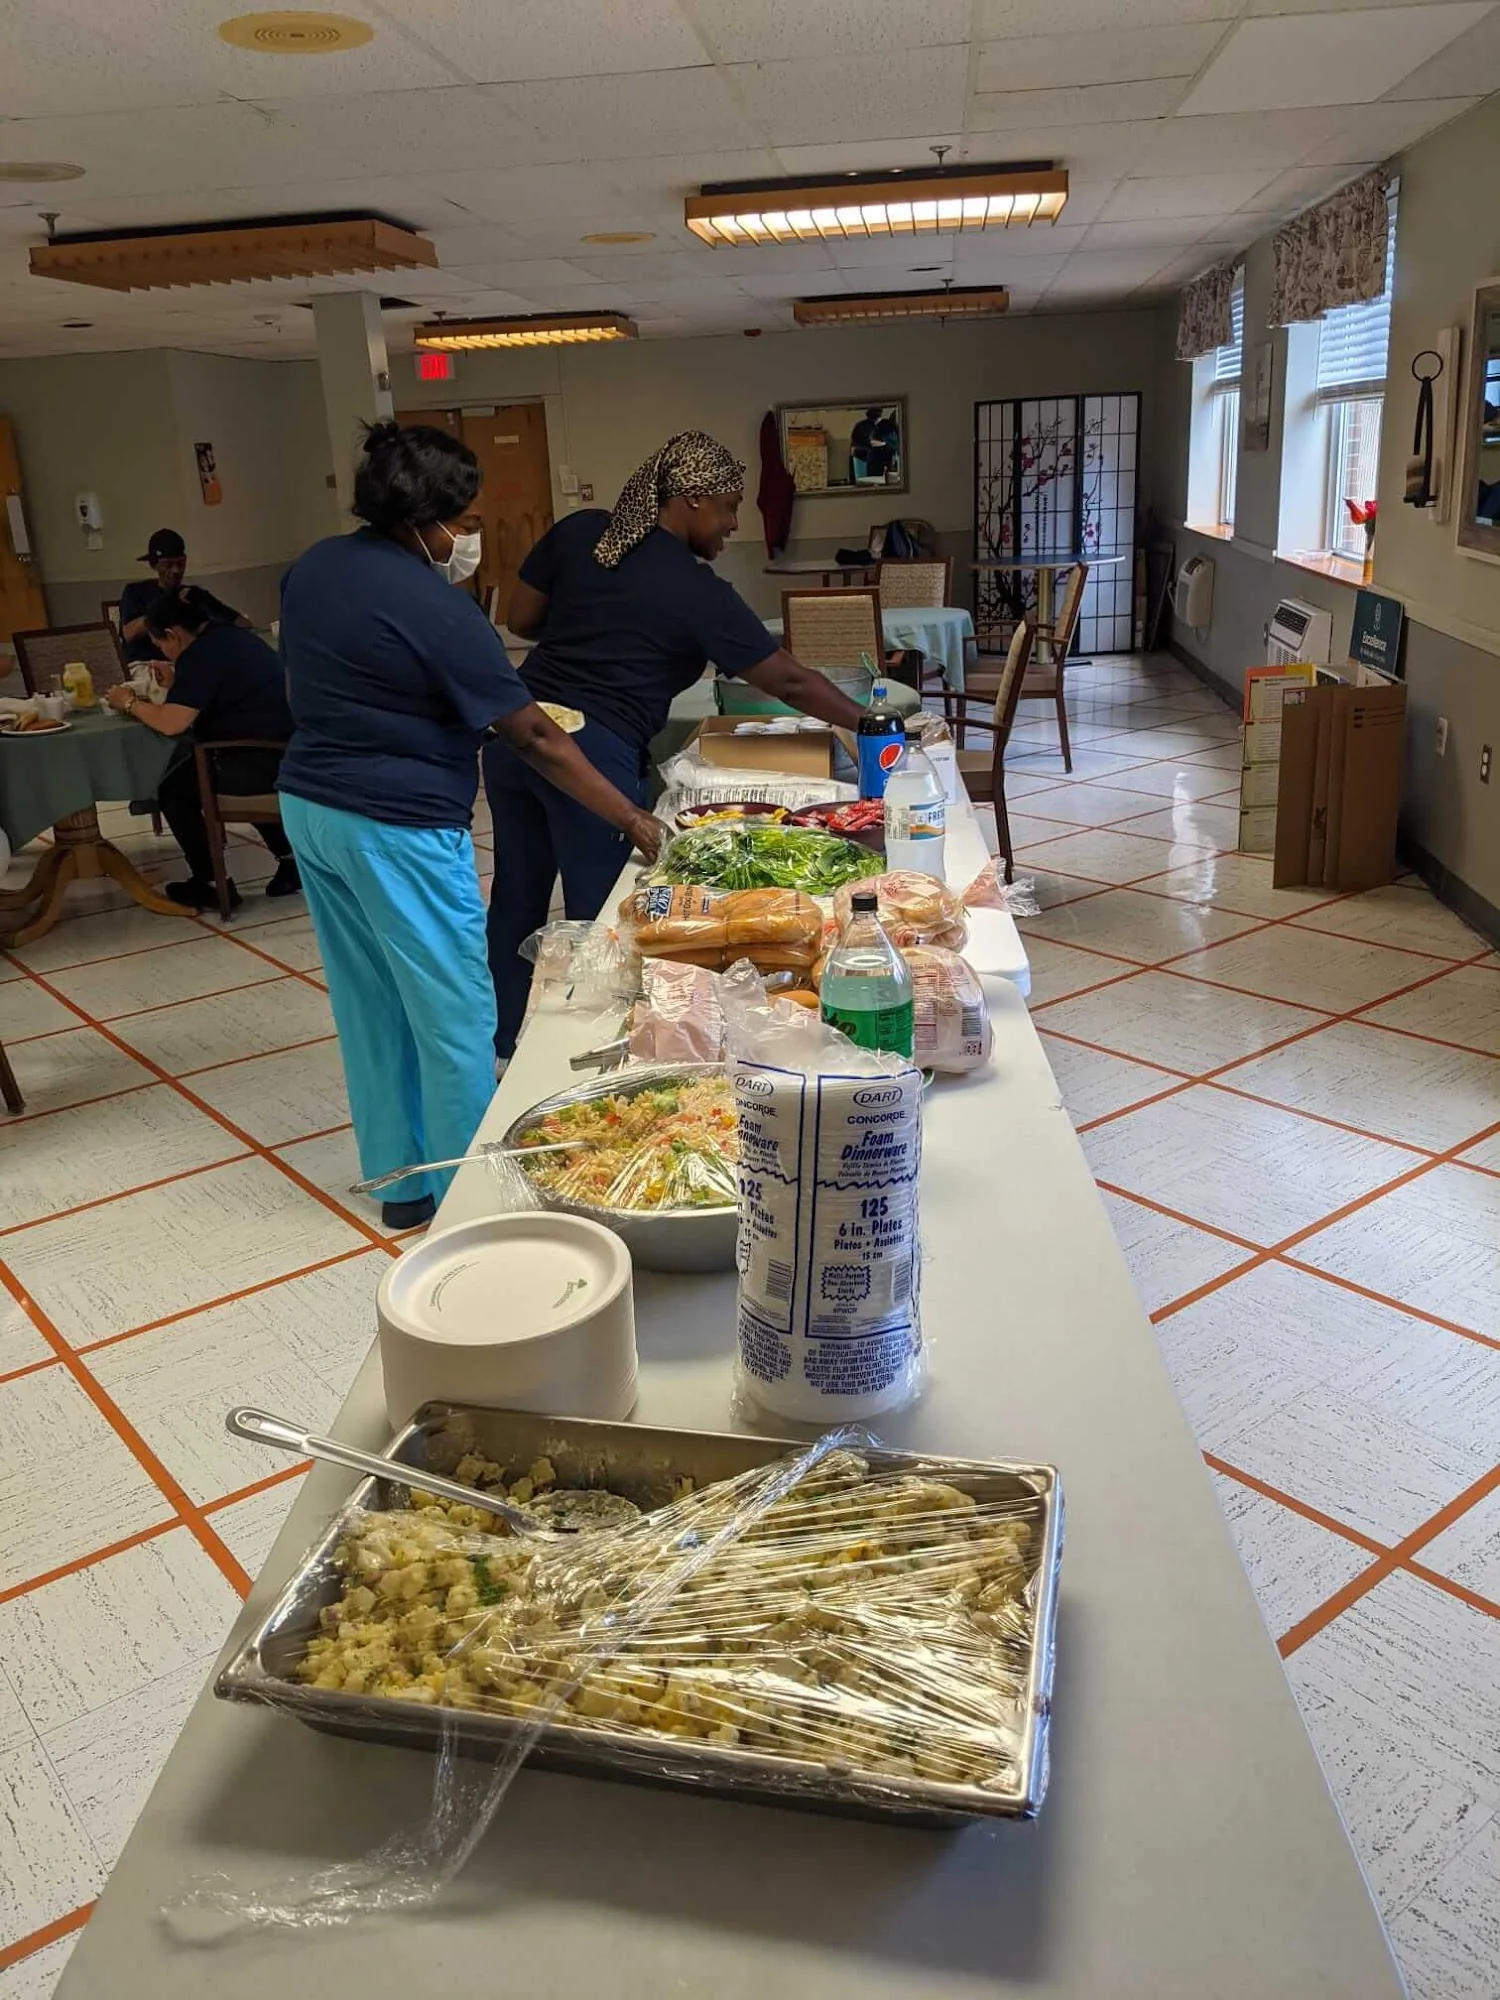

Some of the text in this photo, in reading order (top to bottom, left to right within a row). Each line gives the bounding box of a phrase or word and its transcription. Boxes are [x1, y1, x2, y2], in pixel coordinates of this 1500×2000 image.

[736, 1077, 769, 1092] DART
[860, 1089, 898, 1104] DART
[739, 1114, 762, 1134] Foam
[847, 1110, 905, 1125] CONCORDE
[862, 1130, 893, 1147] Foam
[841, 1143, 907, 1162] Dinnerware
[740, 1178, 762, 1200] 125
[750, 1201, 775, 1225] Plates
[861, 1196, 888, 1218] 125
[839, 1218, 902, 1236] 6 in. Plates
[834, 1238, 862, 1250] Platos
[862, 1252, 870, 1261] 15
[866, 1338, 884, 1347] AVOID
[819, 1349, 862, 1358] SUFFOCATION
[804, 1364, 831, 1373] PLASTIC
[849, 1364, 864, 1372] MAY
[810, 1380, 824, 1388] NOT
[872, 1383, 887, 1391] PLAY
